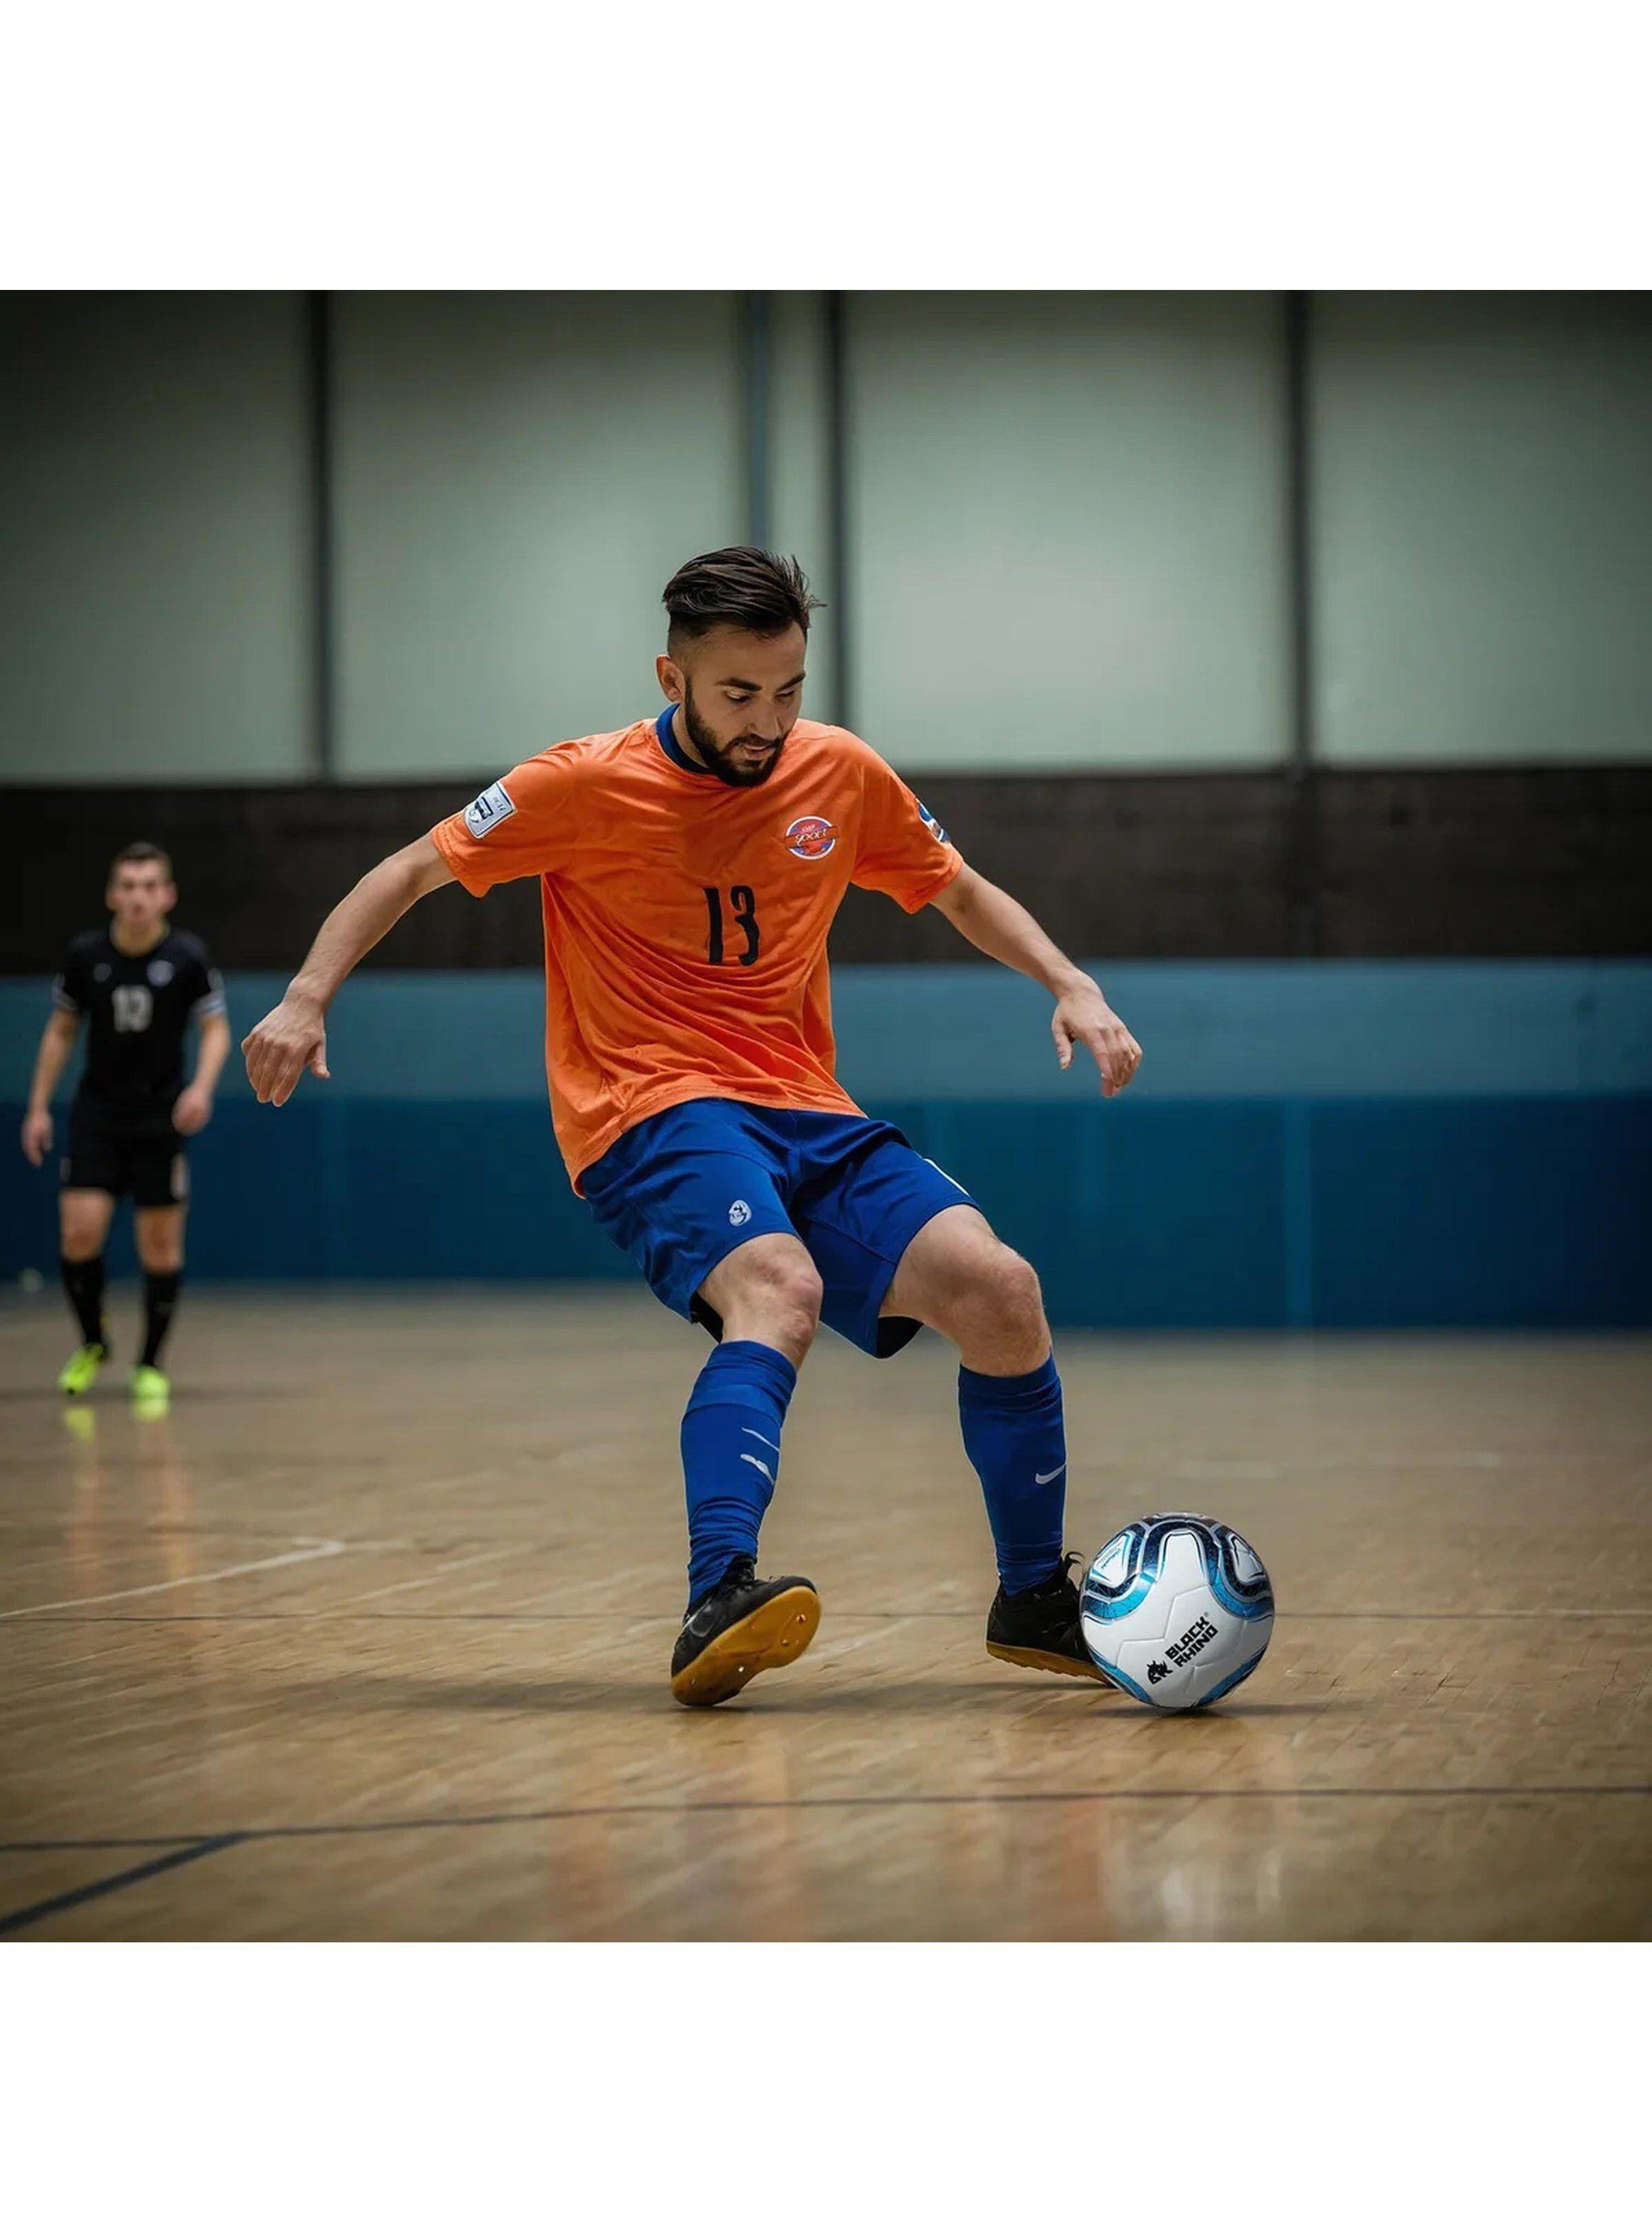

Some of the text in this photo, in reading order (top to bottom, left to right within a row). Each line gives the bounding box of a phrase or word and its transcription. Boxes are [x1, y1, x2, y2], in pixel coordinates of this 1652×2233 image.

[702, 885, 760, 966] 13
[1164, 1616, 1210, 1660] BLACK
[1173, 1624, 1218, 1668] RHINO
